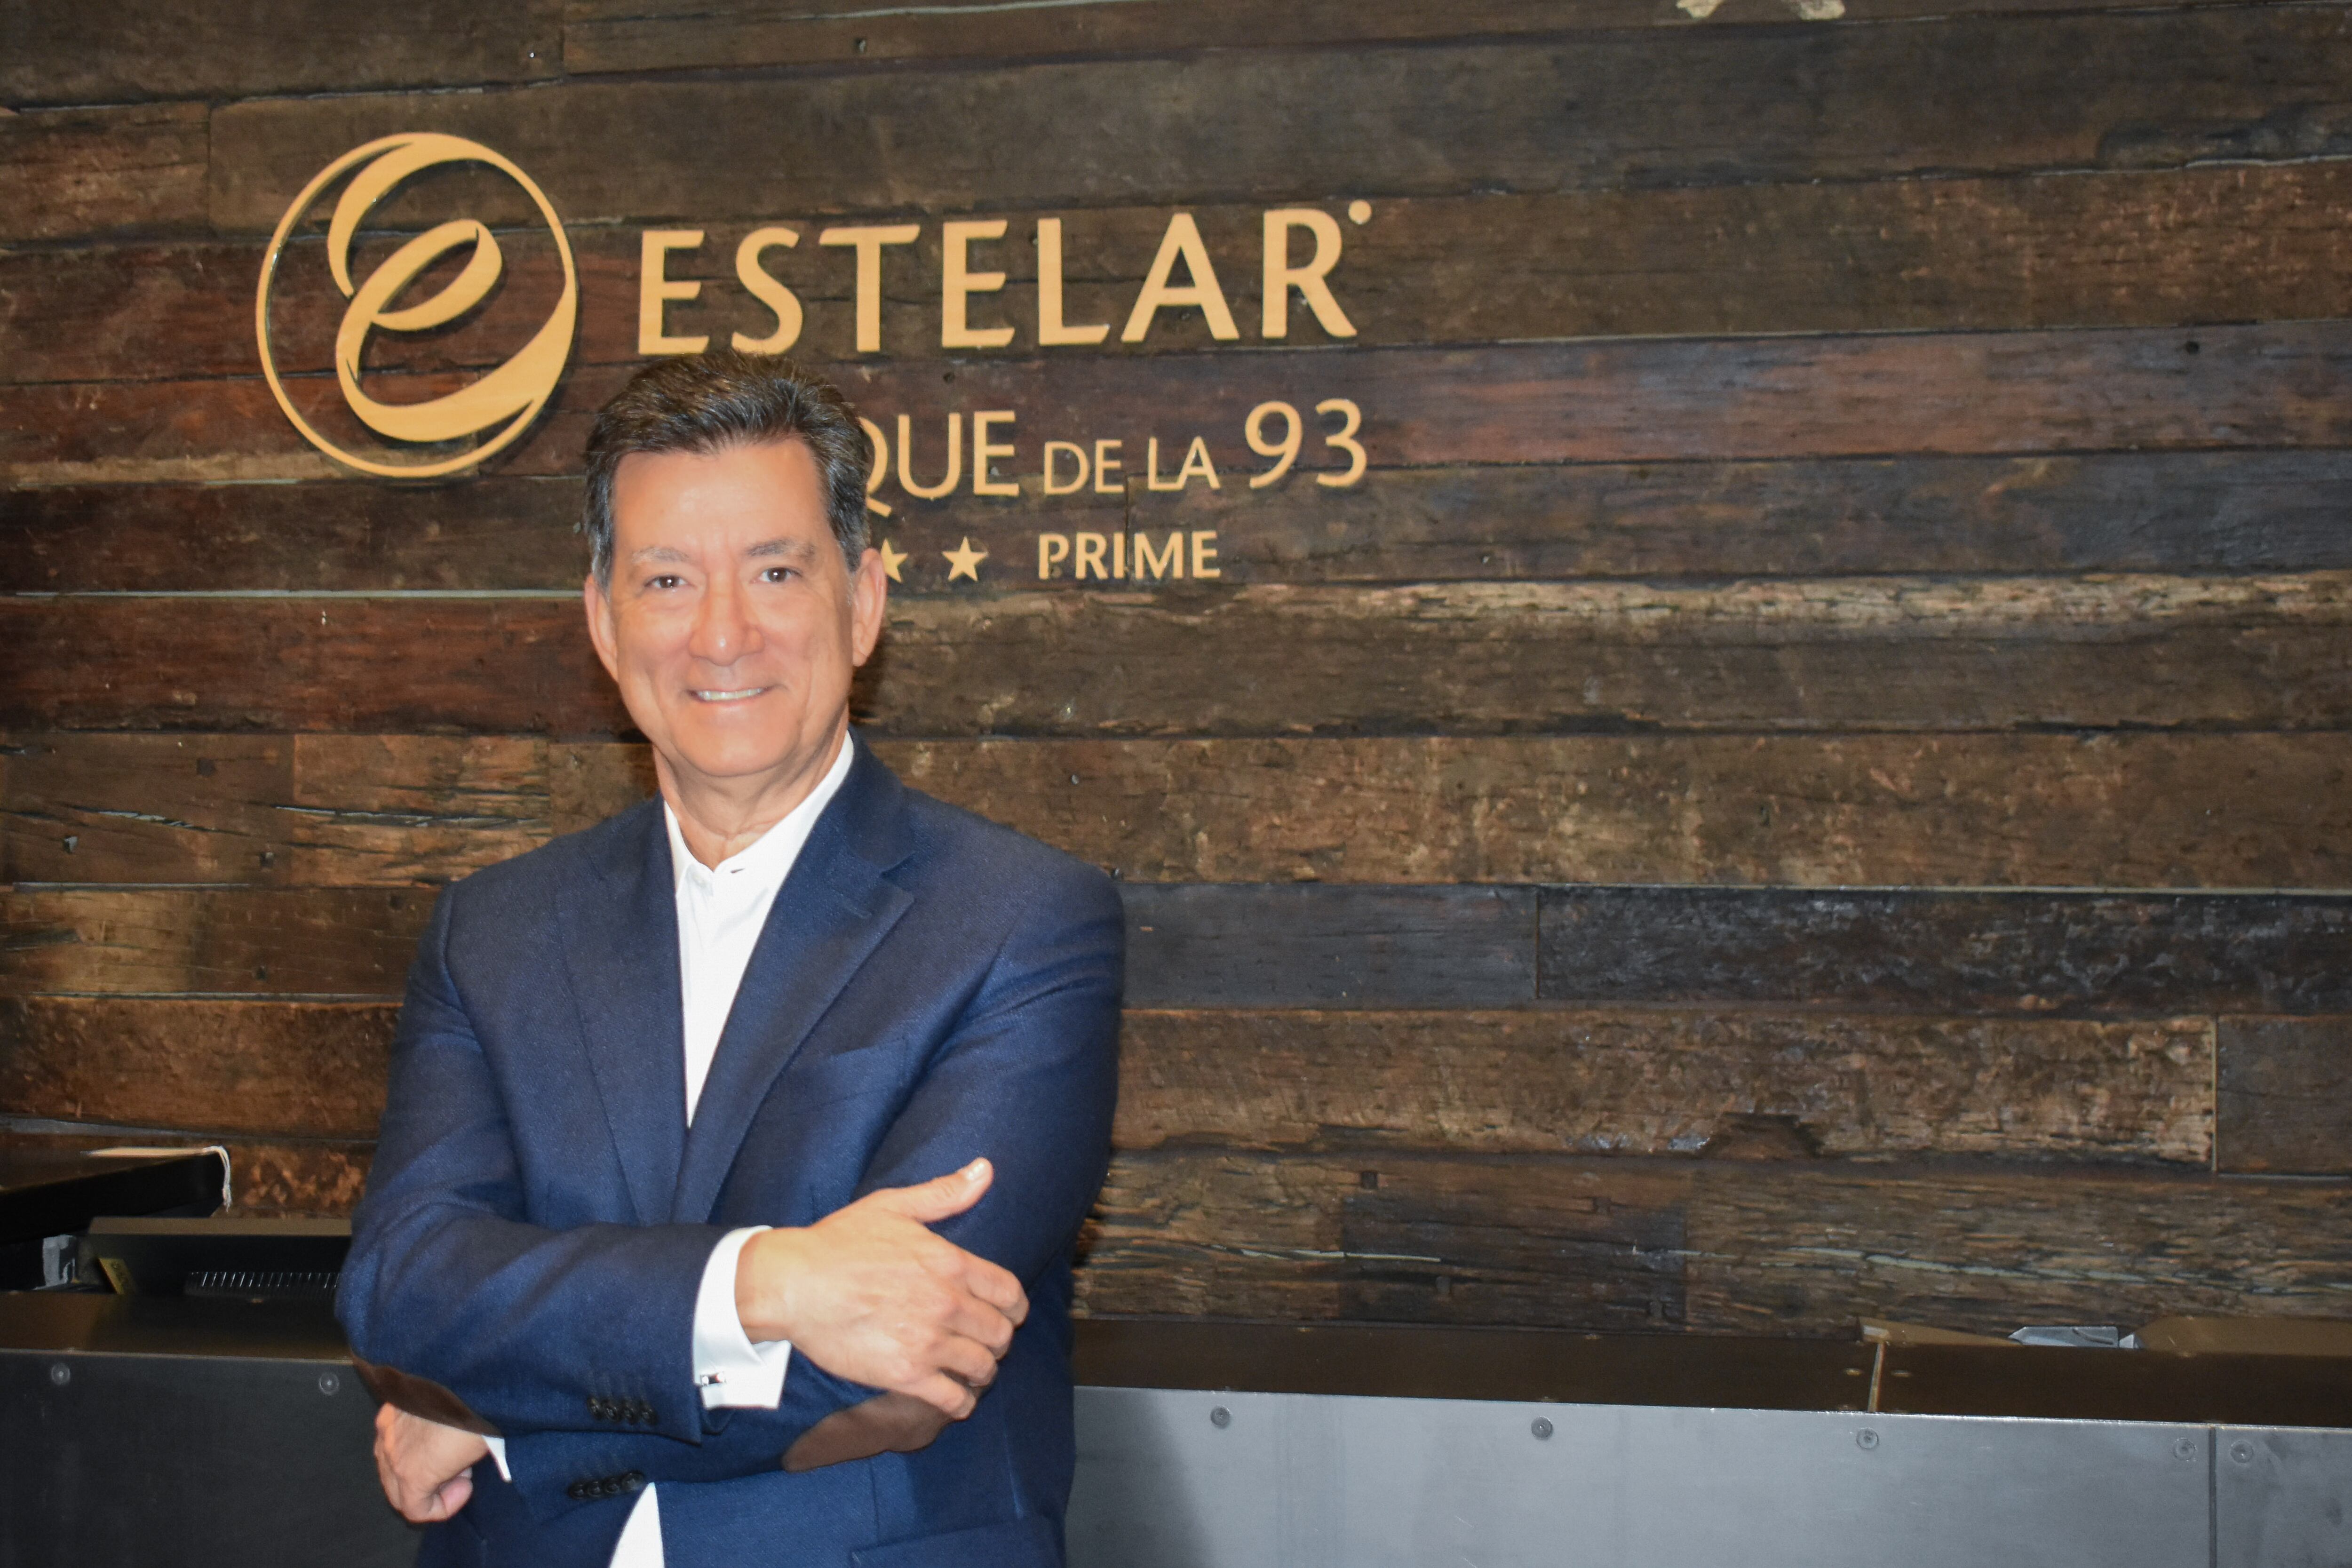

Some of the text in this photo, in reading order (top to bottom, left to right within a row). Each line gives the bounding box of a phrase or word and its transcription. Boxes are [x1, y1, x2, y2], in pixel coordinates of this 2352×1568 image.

[638, 209, 1358, 355] ESTELAR
[1043, 439, 1125, 494] DE
[1148, 437, 1220, 491] LA
[1245, 398, 1367, 488] 93
[1038, 531, 1221, 580] PRIME
